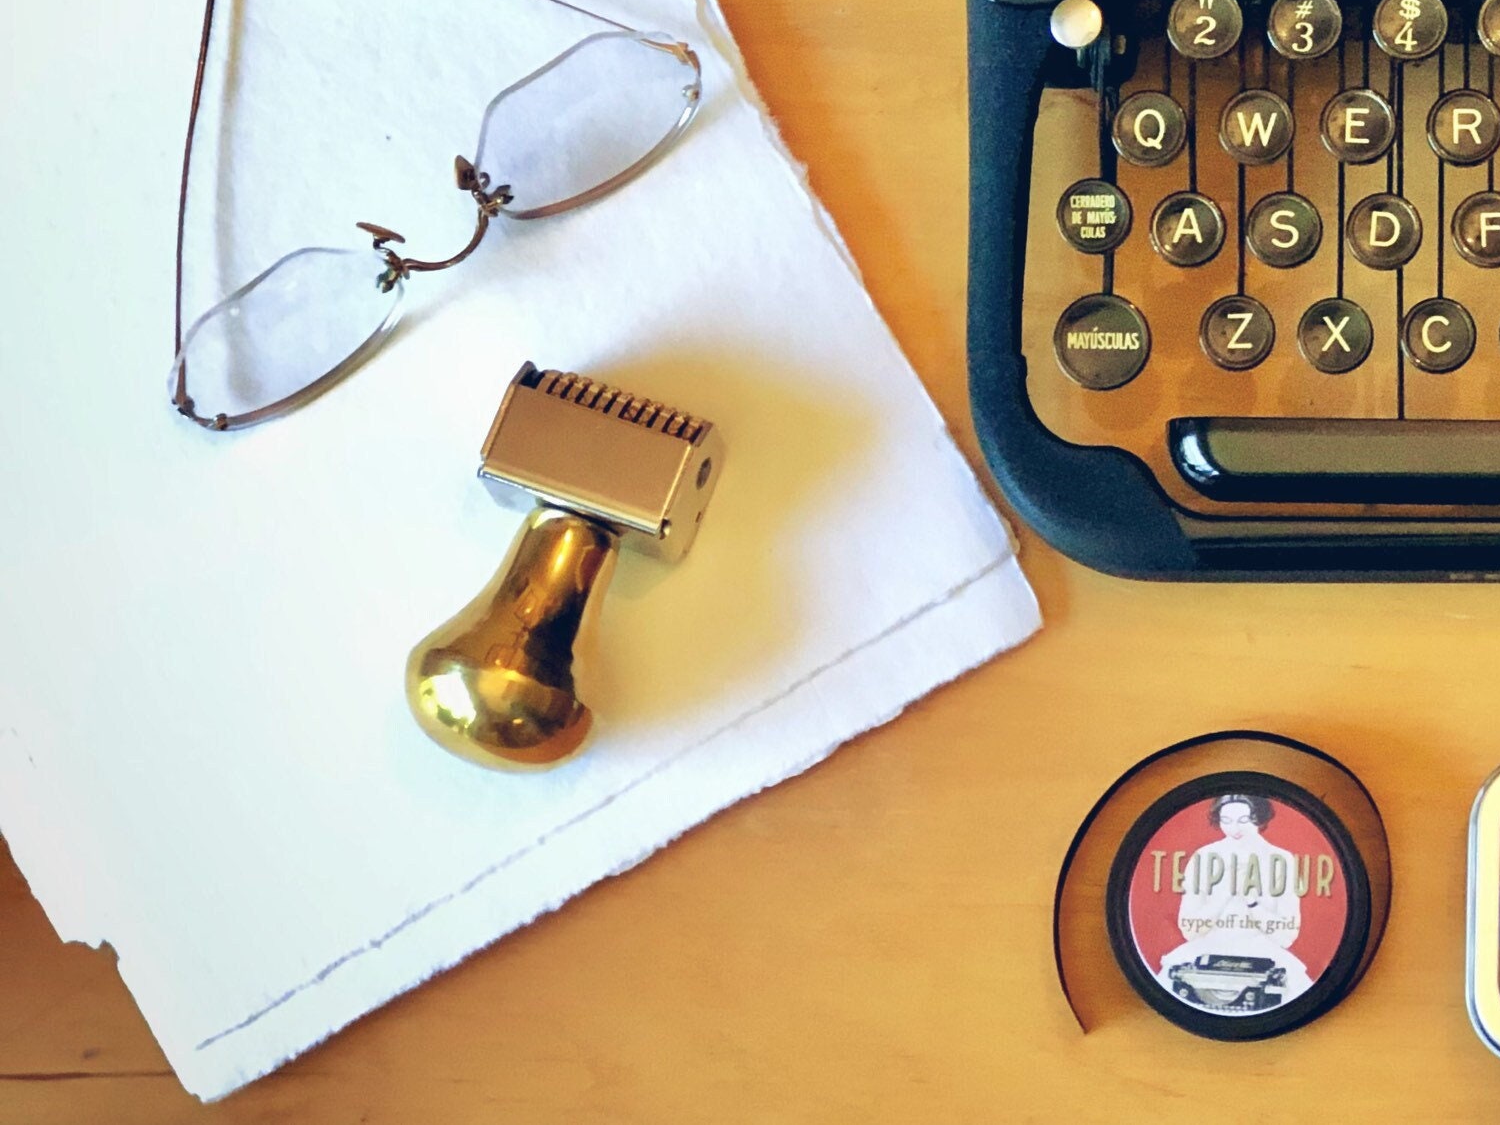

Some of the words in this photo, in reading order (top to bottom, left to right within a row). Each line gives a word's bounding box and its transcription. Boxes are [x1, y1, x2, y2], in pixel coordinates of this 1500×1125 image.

[1193, 16, 1217, 45] 2
[1292, 22, 1314, 53] 3
[1394, 21, 1418, 51] 4
[1134, 108, 1166, 150] Q
[1236, 112, 1277, 147] W
[1344, 107, 1370, 144] E
[1452, 108, 1482, 145] R
[1172, 207, 1203, 244] A
[1269, 210, 1299, 248] S
[1369, 210, 1401, 247] D
[1067, 326, 1140, 350] MAYÚSCULAS
[1226, 312, 1253, 349] Z
[1321, 316, 1351, 352] X
[1421, 315, 1452, 353] C
[1151, 850, 1335, 898] TEIPIADUR
[1181, 915, 1213, 934] type
[1216, 913, 1237, 929] off
[1239, 913, 1262, 930] the
[1265, 915, 1300, 935] grid.
